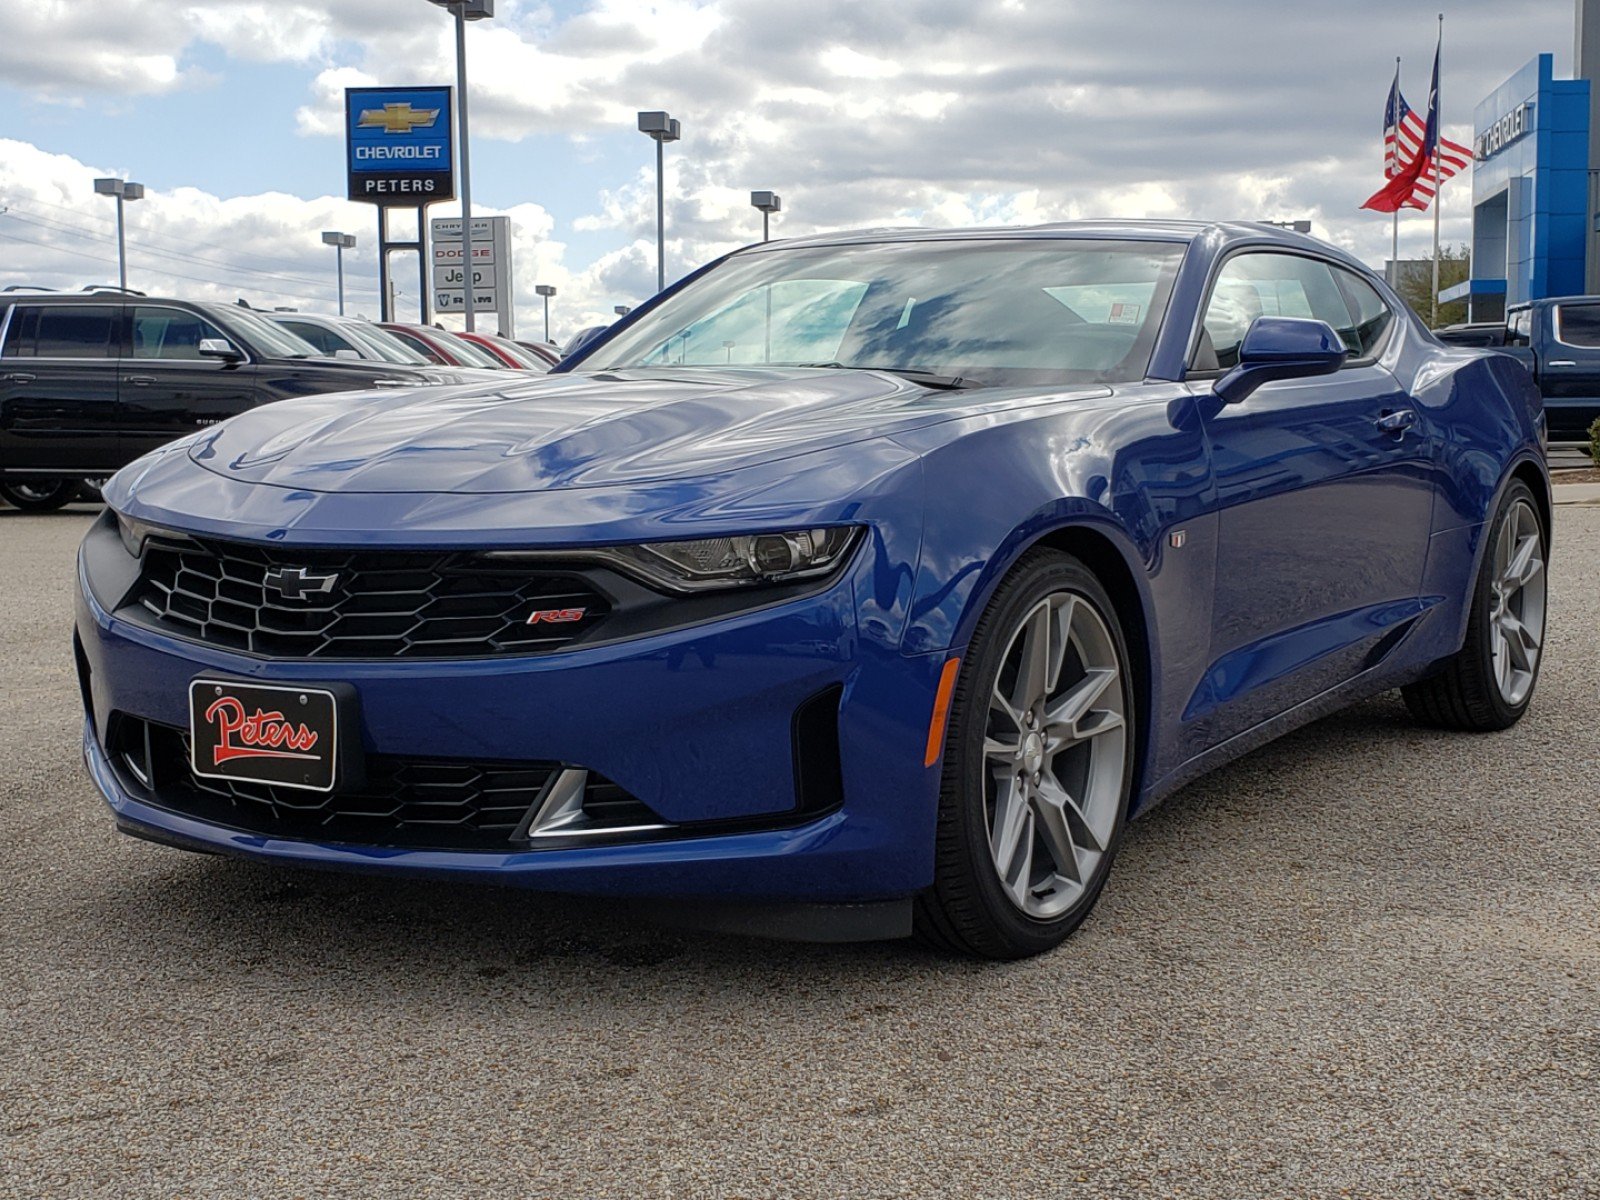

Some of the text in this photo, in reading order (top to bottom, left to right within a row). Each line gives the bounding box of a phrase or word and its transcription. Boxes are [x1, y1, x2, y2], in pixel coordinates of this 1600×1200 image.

[1486, 102, 1527, 156] CHEVROLET
[356, 146, 442, 160] CHEVROLET
[365, 179, 435, 192] PETERS
[445, 269, 482, 284] Jep
[453, 296, 492, 304] RM
[526, 607, 586, 624] RS
[205, 696, 320, 756] Peters
